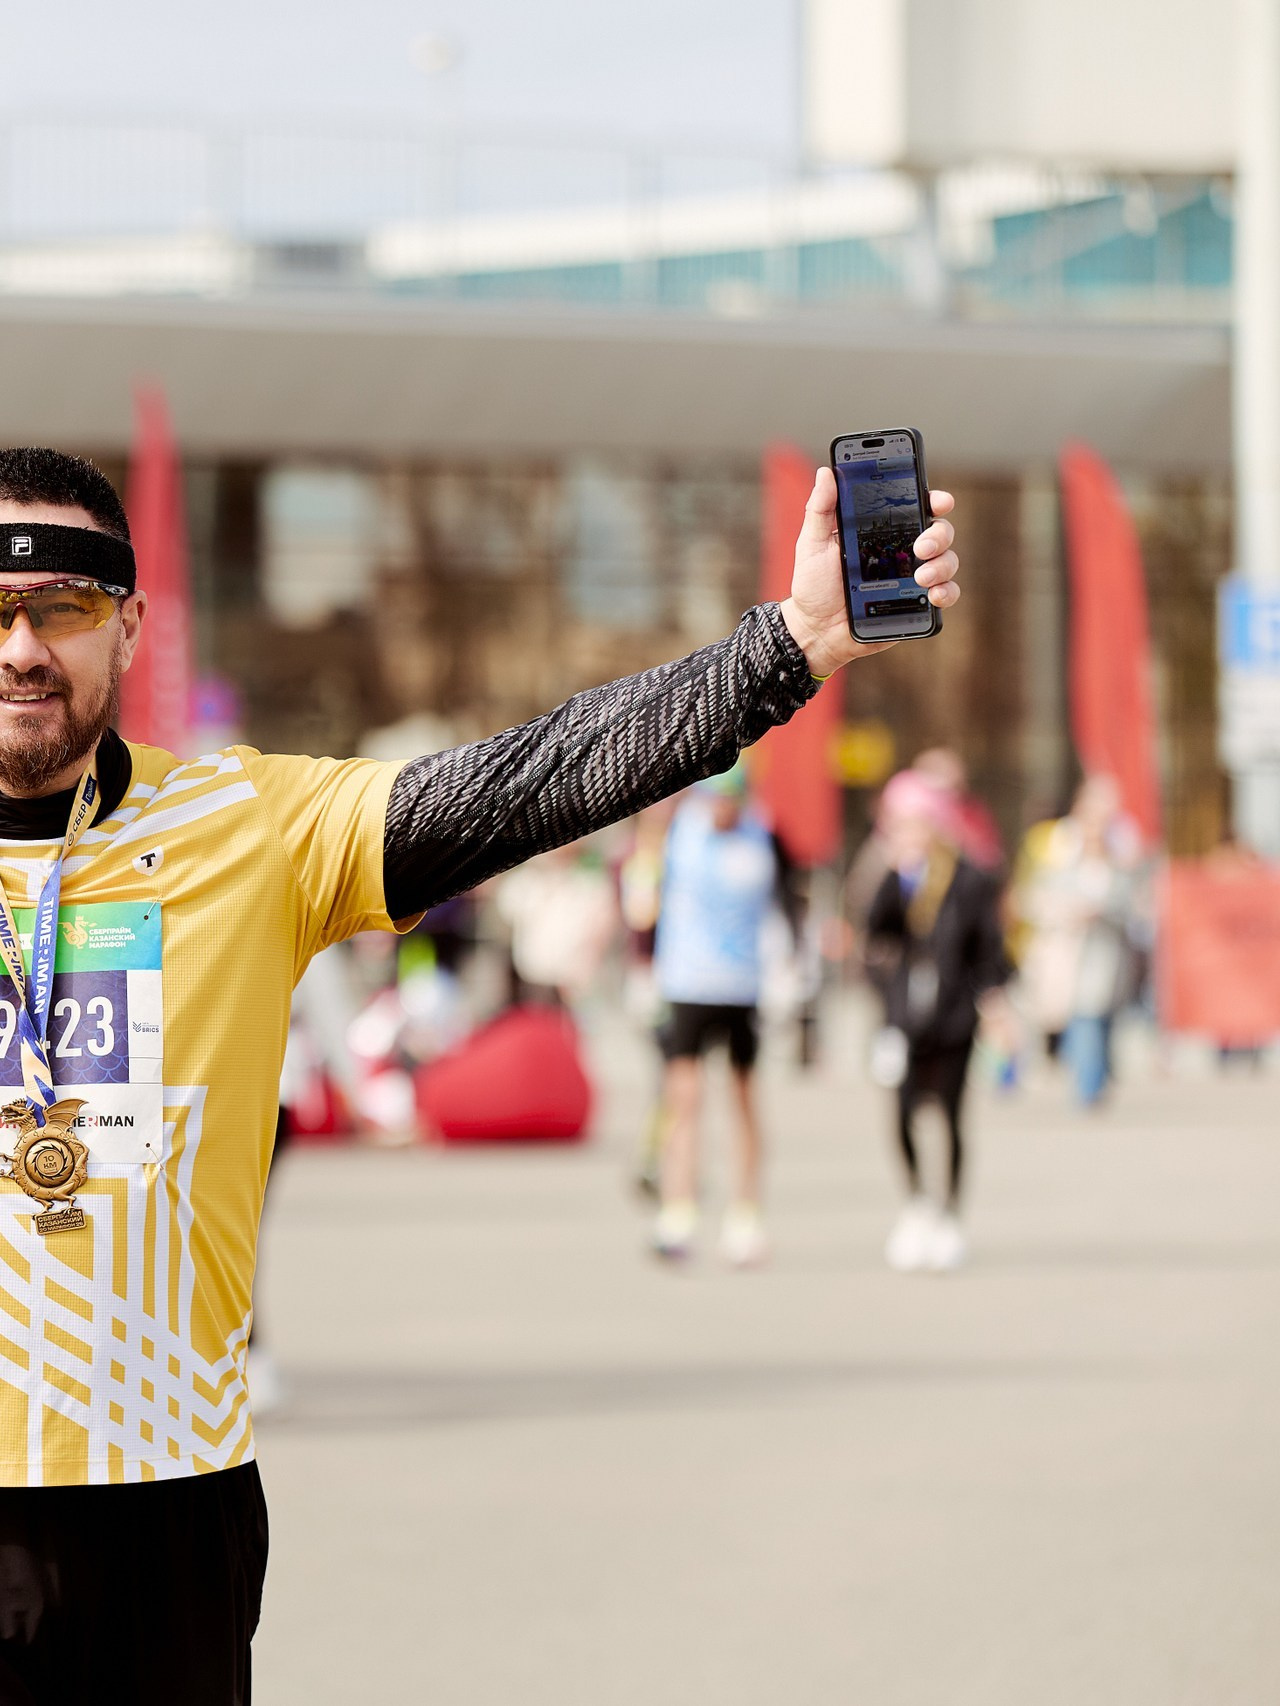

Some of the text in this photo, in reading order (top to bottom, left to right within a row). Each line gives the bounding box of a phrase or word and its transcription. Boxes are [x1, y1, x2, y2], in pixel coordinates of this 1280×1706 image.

[72, 803, 87, 832] СБЕР
[89, 927, 131, 936] СБЕРПРАЙМ
[89, 933, 135, 942] КАЗАНСКИЙ
[89, 941, 126, 949] МАРАФОН
[73, 1115, 134, 1127] ERMAN
